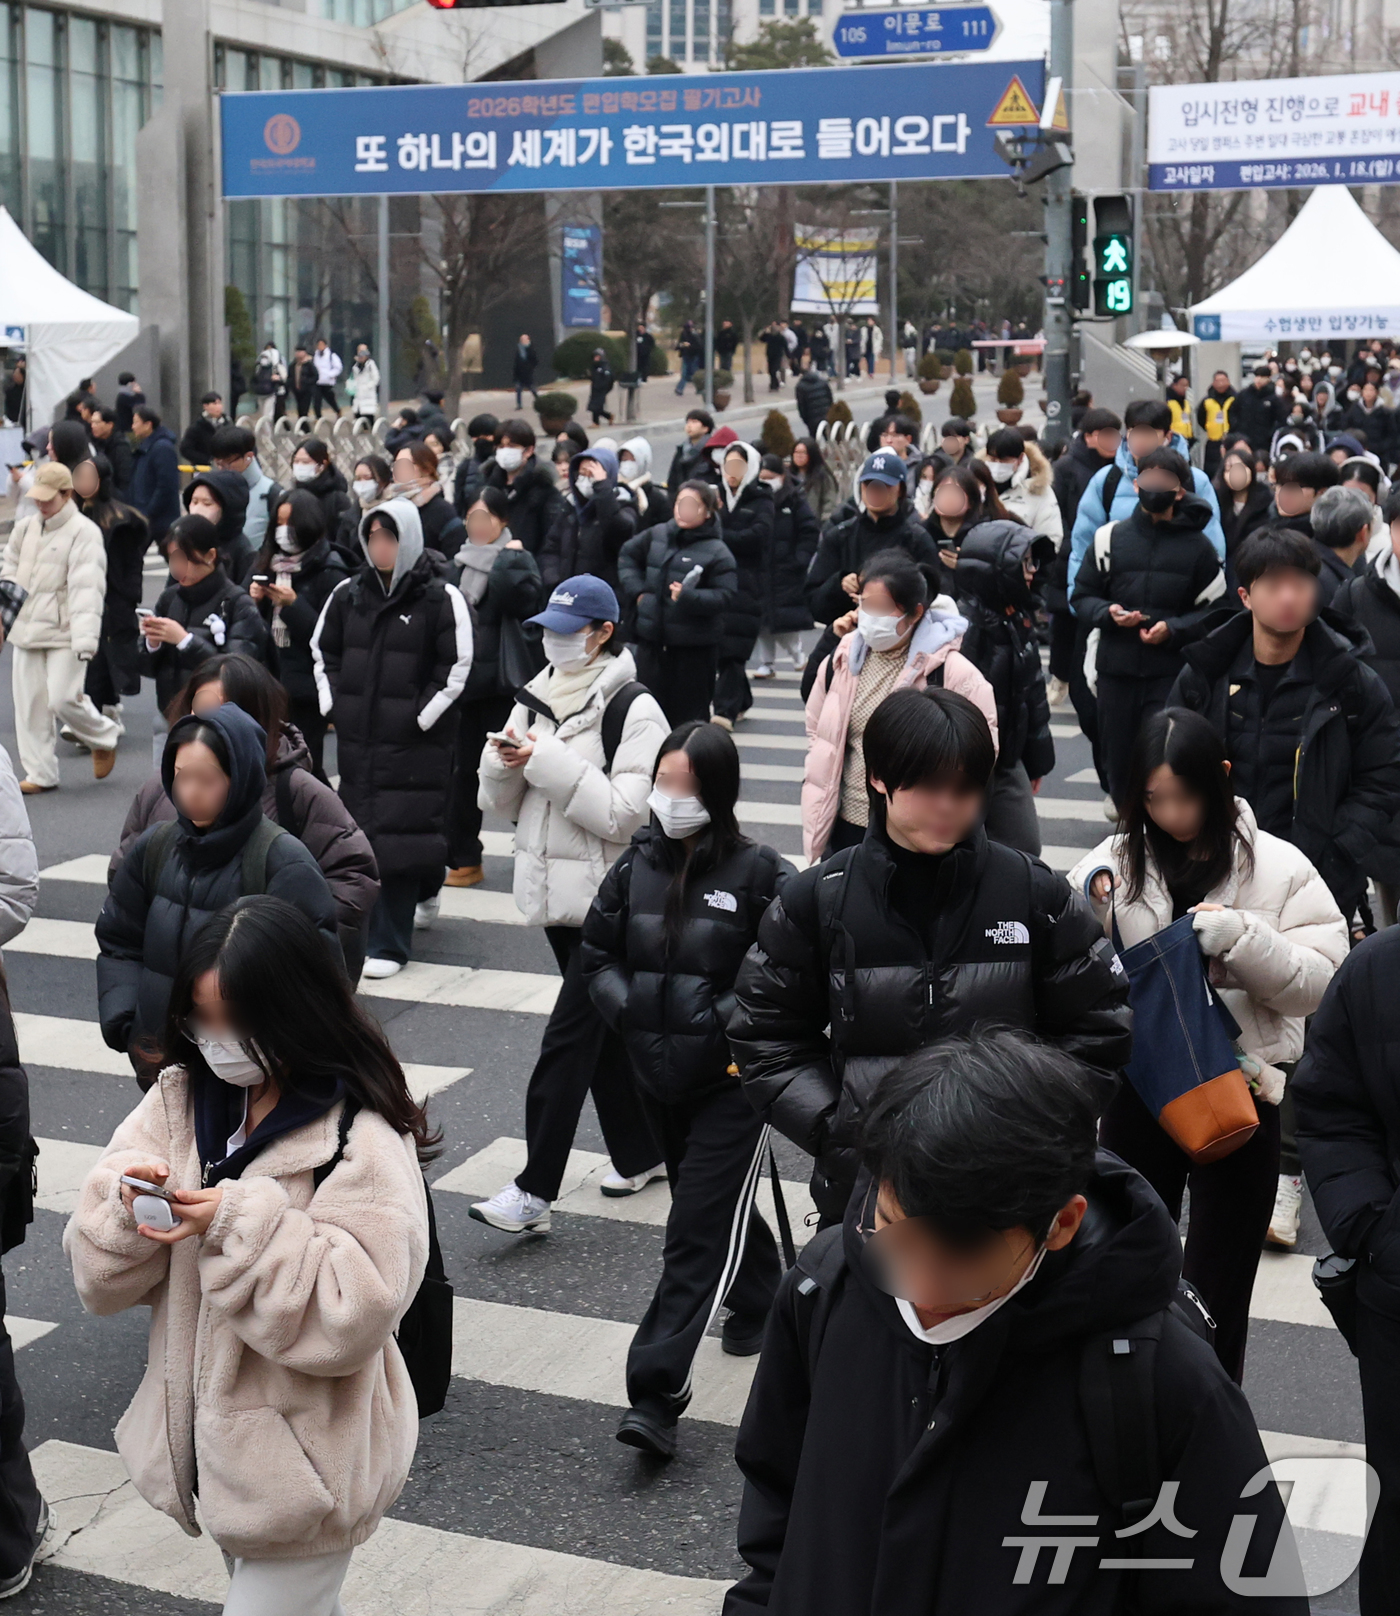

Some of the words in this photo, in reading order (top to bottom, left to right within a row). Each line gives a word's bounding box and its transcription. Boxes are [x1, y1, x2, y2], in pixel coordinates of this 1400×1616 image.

[882, 12, 944, 36] 이문로
[962, 20, 987, 37] 111
[840, 27, 867, 43] 105
[467, 93, 577, 118] 2026학년도
[582, 90, 678, 115] 편입학모집
[683, 86, 762, 112] 필기고사
[1181, 96, 1259, 127] 입시전형
[1265, 95, 1340, 123] 진행으로
[1346, 90, 1390, 118] 교내
[354, 135, 389, 172] 또
[397, 130, 497, 172] 하나의
[507, 127, 614, 169] 세계가
[622, 120, 806, 165] 한국외대로
[816, 112, 972, 160] 들어오다
[1163, 165, 1215, 185] 고사일자
[1107, 279, 1130, 311] 19
[1264, 314, 1322, 333] 수험생만
[1328, 313, 1389, 331] 입장가능
[985, 928, 1014, 937] NORTH
[997, 921, 1014, 929] THE
[993, 936, 1015, 944] FACE
